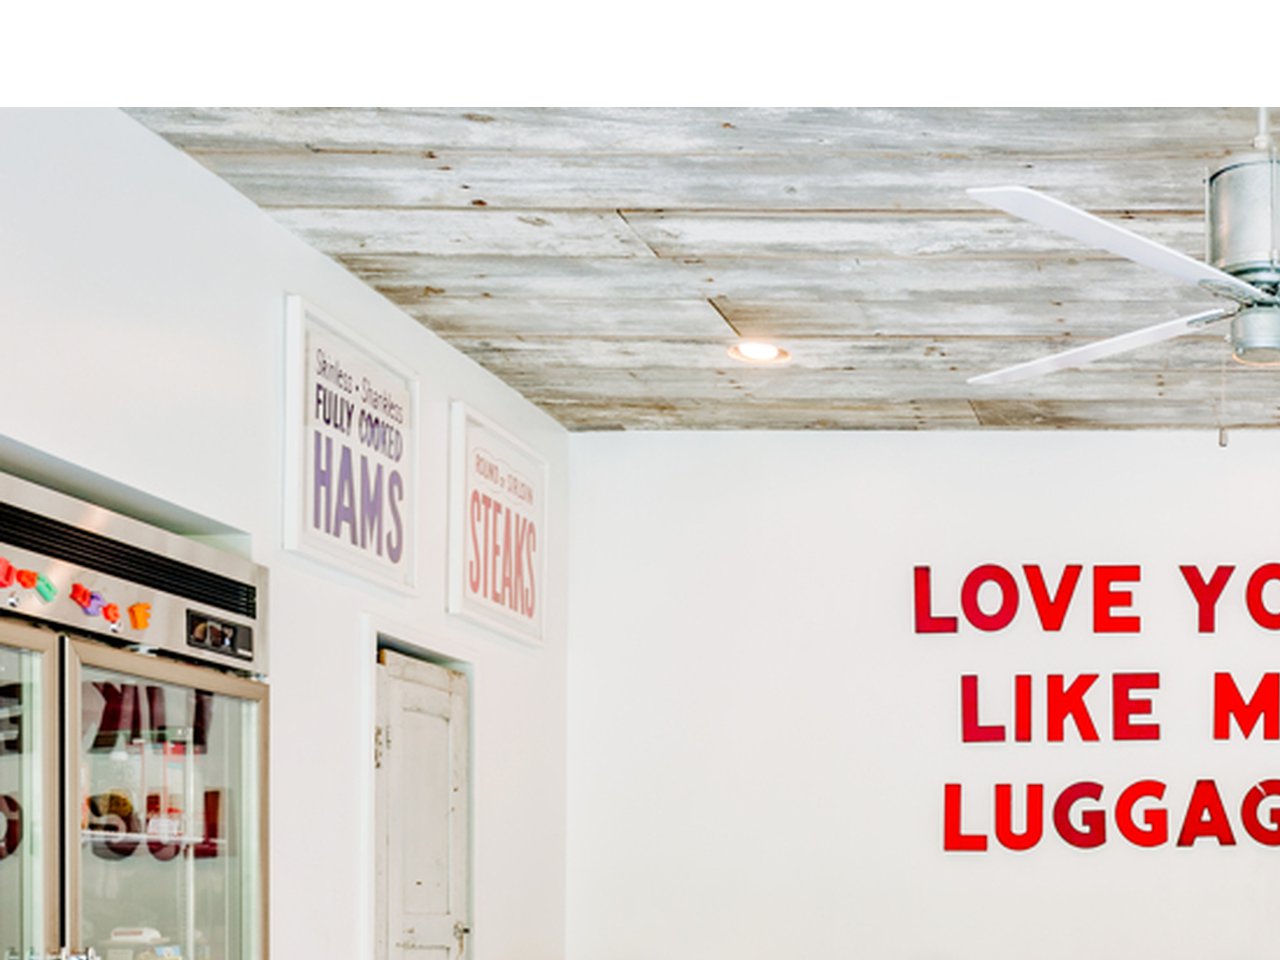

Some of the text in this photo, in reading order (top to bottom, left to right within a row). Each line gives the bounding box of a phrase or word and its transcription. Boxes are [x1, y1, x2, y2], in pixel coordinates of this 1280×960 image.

[315, 383, 404, 463] FULLY COOKED
[313, 430, 404, 564] HAMS
[469, 490, 536, 619] STEAKS
[913, 563, 1141, 634] LOVE
[961, 672, 1160, 742] LIKE
